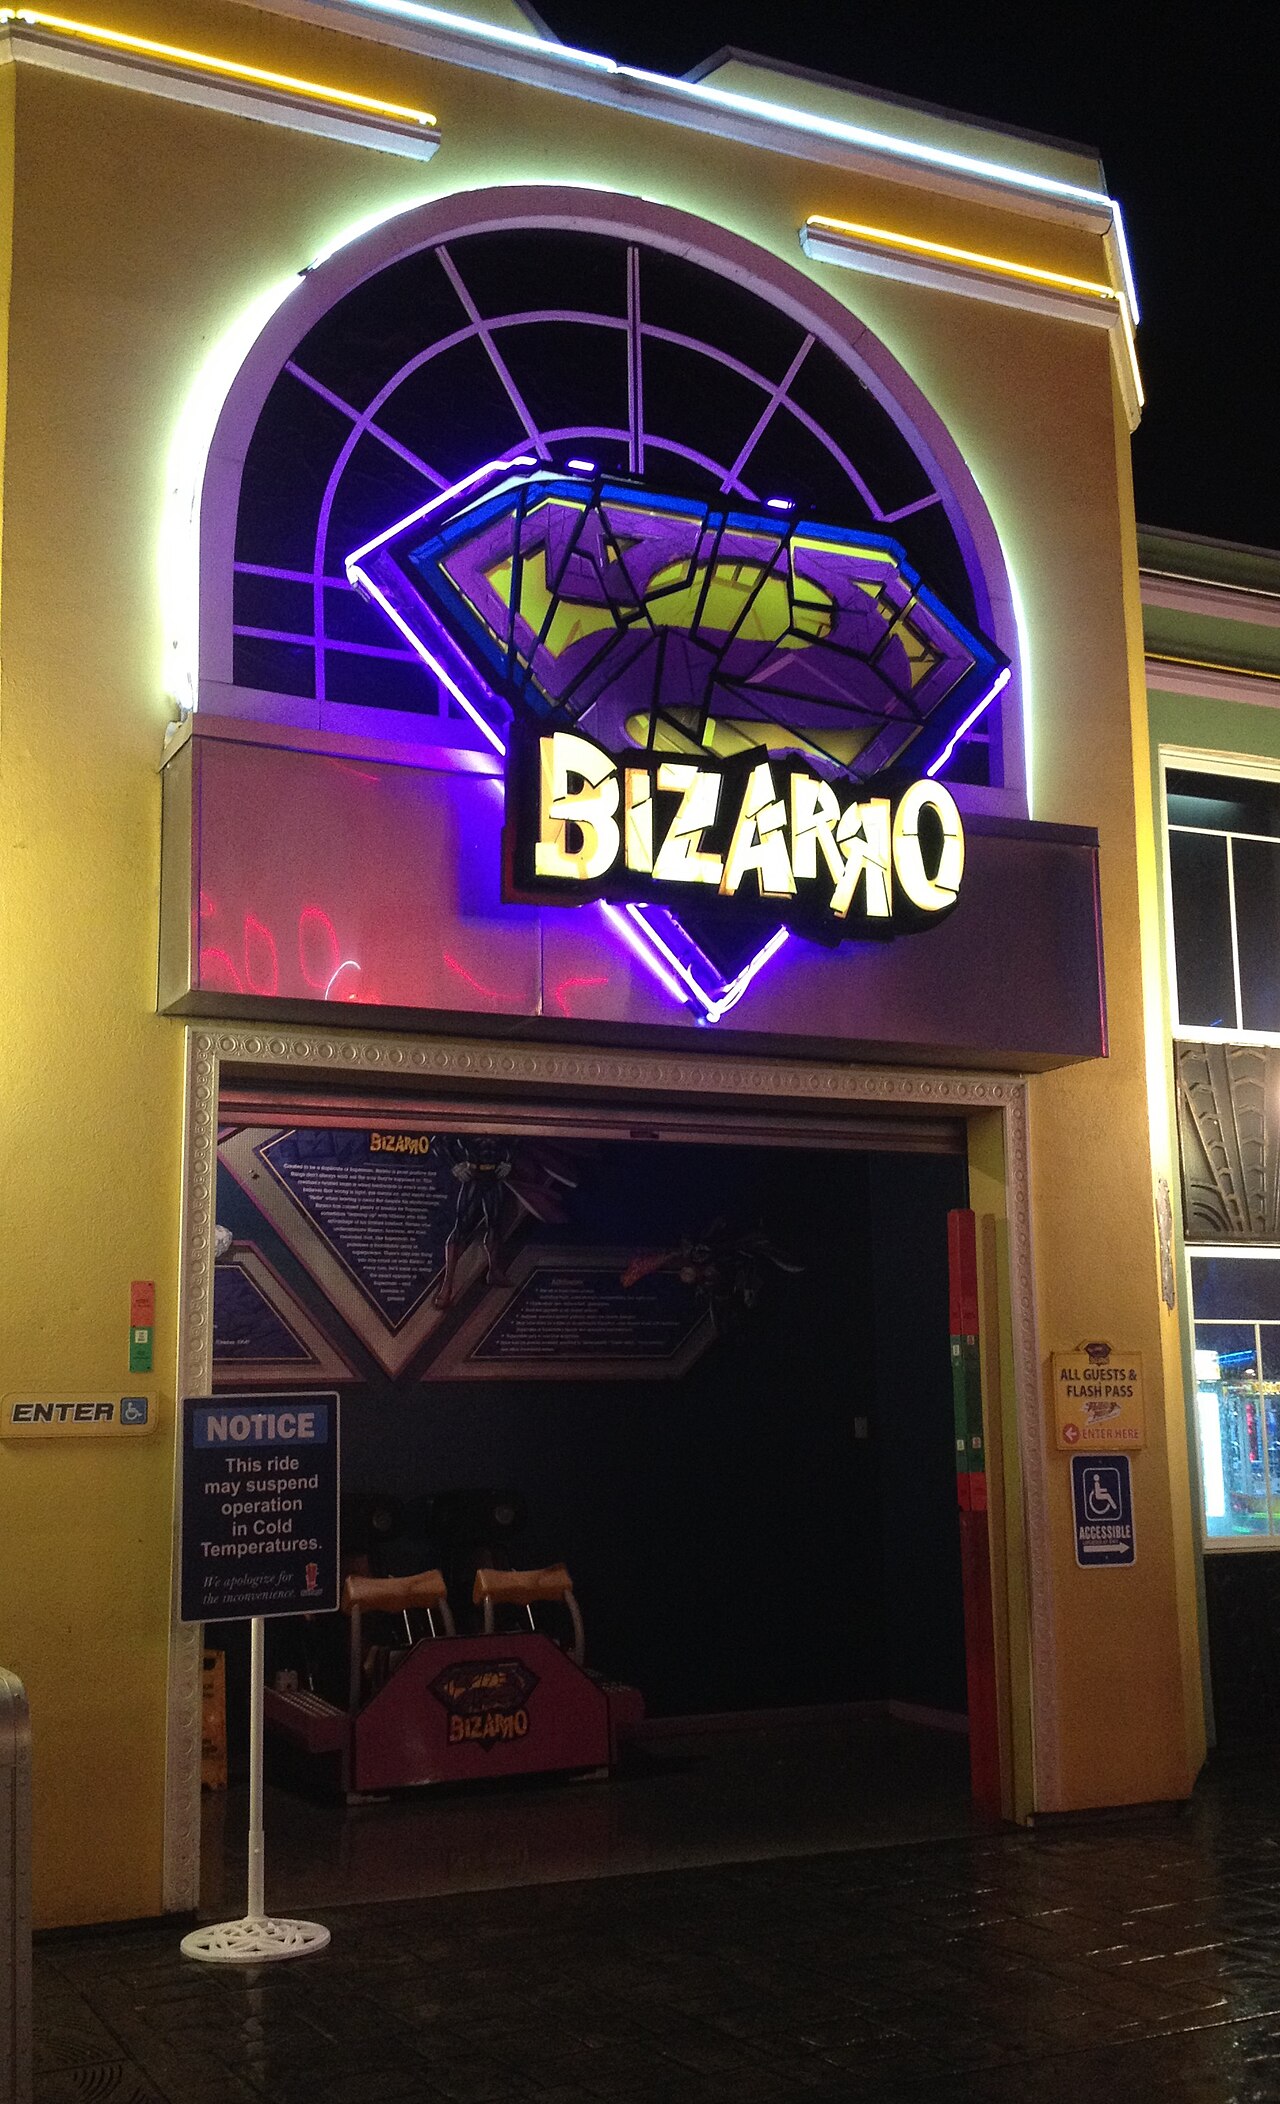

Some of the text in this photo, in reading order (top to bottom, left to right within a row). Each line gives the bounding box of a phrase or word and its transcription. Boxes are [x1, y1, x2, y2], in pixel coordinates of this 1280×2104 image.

[535, 731, 965, 919] BIZARRO
[1061, 1368, 1138, 1381] ALL GUESTS &
[1066, 1385, 1134, 1398] FLASH PASS
[11, 1402, 115, 1423] ENTER
[206, 1412, 316, 1442] NOTICE
[1082, 1428, 1139, 1440] ENTER HERE
[225, 1455, 300, 1473] This ride
[204, 1474, 319, 1497] may suspend
[221, 1497, 303, 1518] operation
[232, 1518, 293, 1537] in Cold
[1079, 1524, 1132, 1540] ACCESSIBLE
[201, 1536, 323, 1559] Temperatures.
[203, 1570, 295, 1591] We apologize for
[203, 1592, 219, 1605] the
